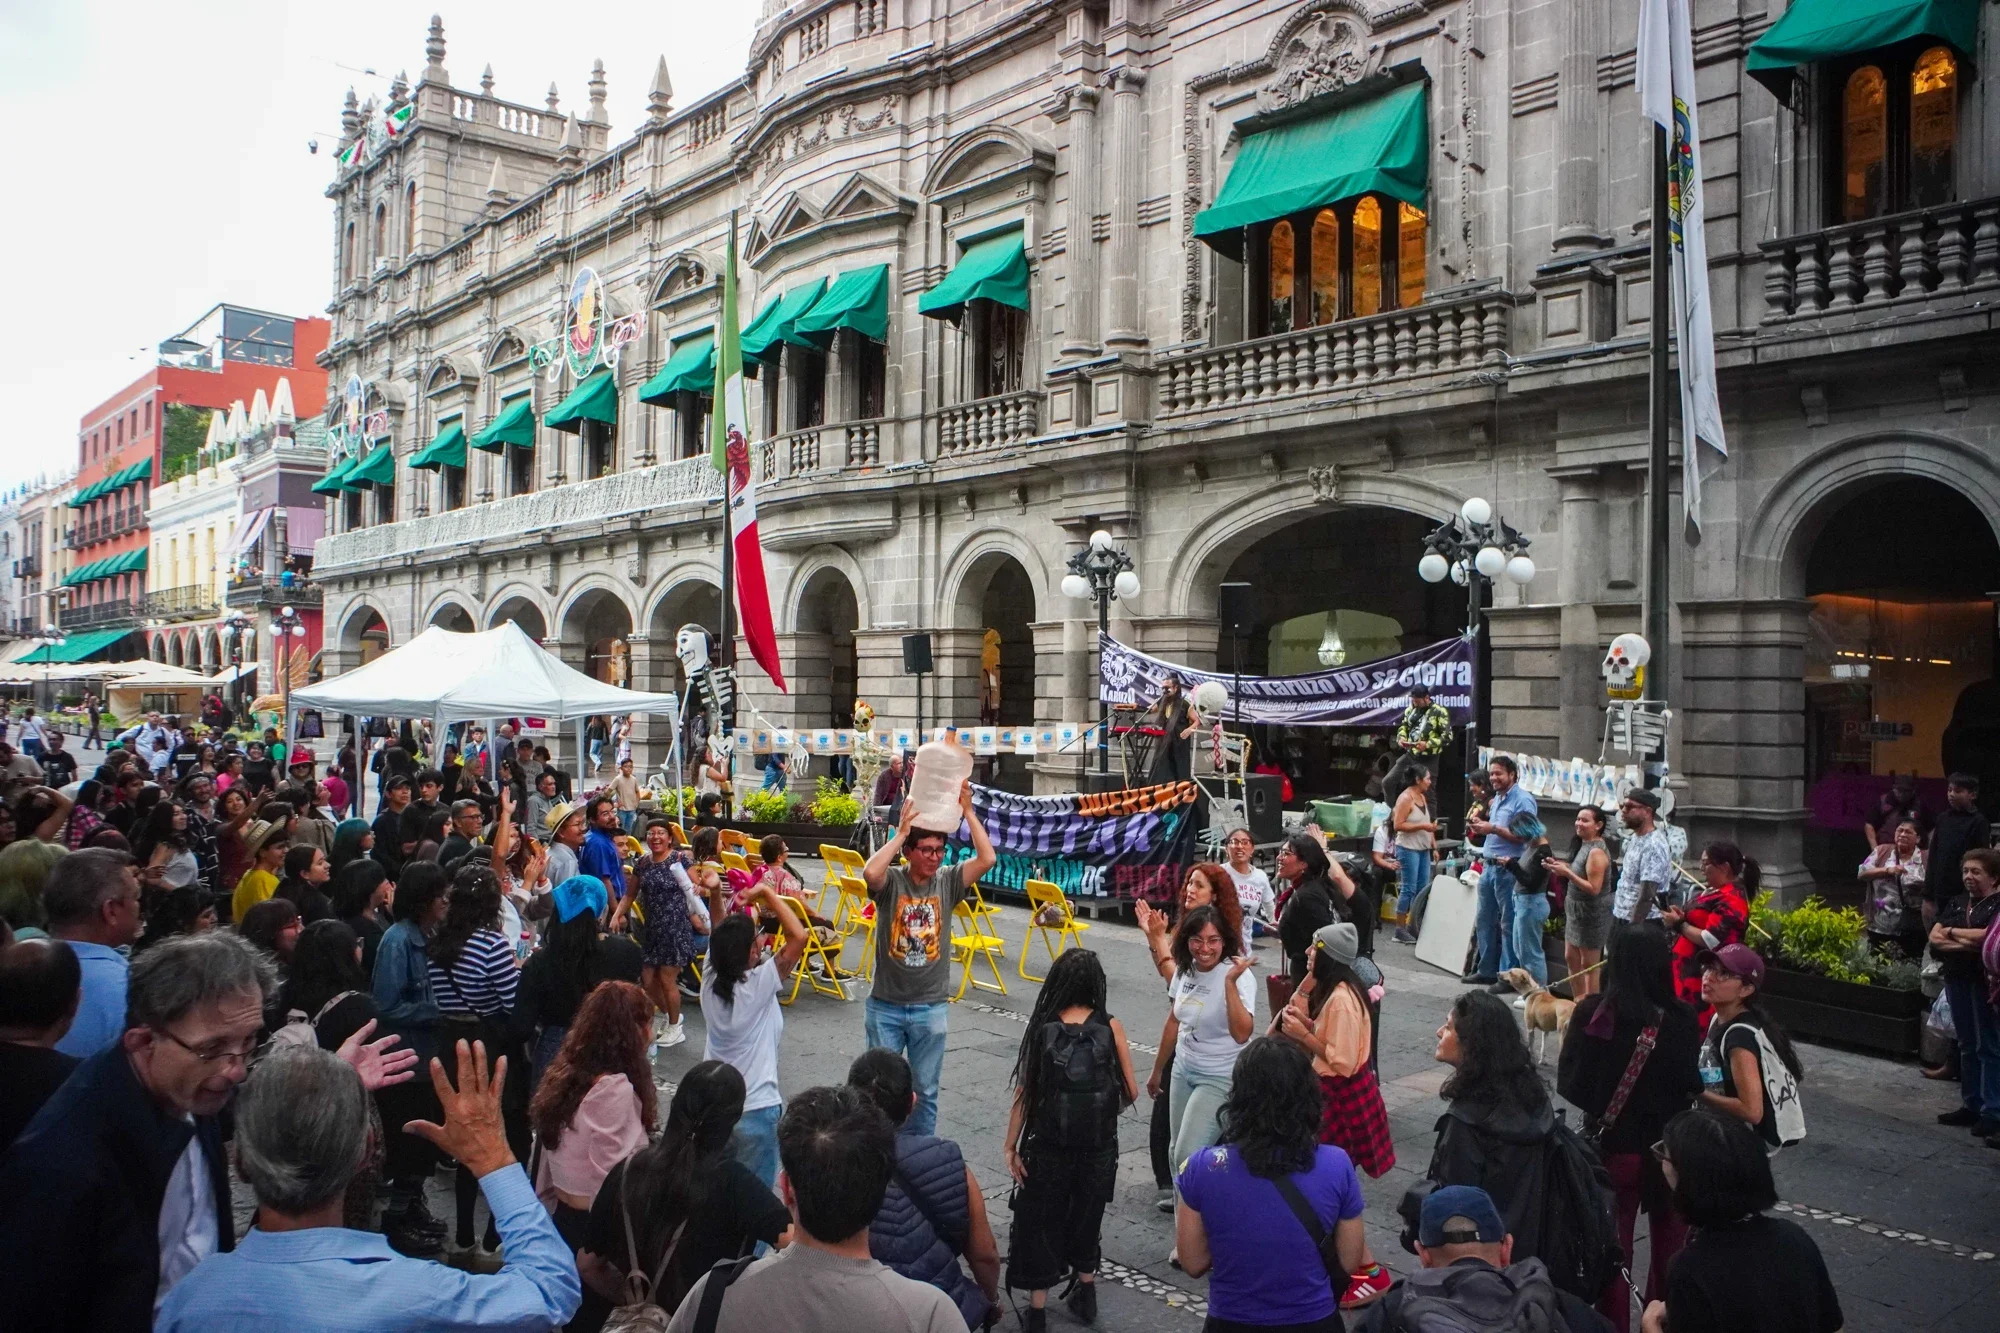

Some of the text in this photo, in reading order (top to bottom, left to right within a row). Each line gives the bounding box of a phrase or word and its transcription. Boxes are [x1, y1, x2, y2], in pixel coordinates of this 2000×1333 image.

[1334, 671, 1370, 693] NO
[1371, 668, 1399, 690] se
[1399, 660, 1472, 687] cierra
[1337, 695, 1381, 710] merecen
[988, 789, 1075, 816] CIUDAD
[1081, 865, 1108, 897] DE
